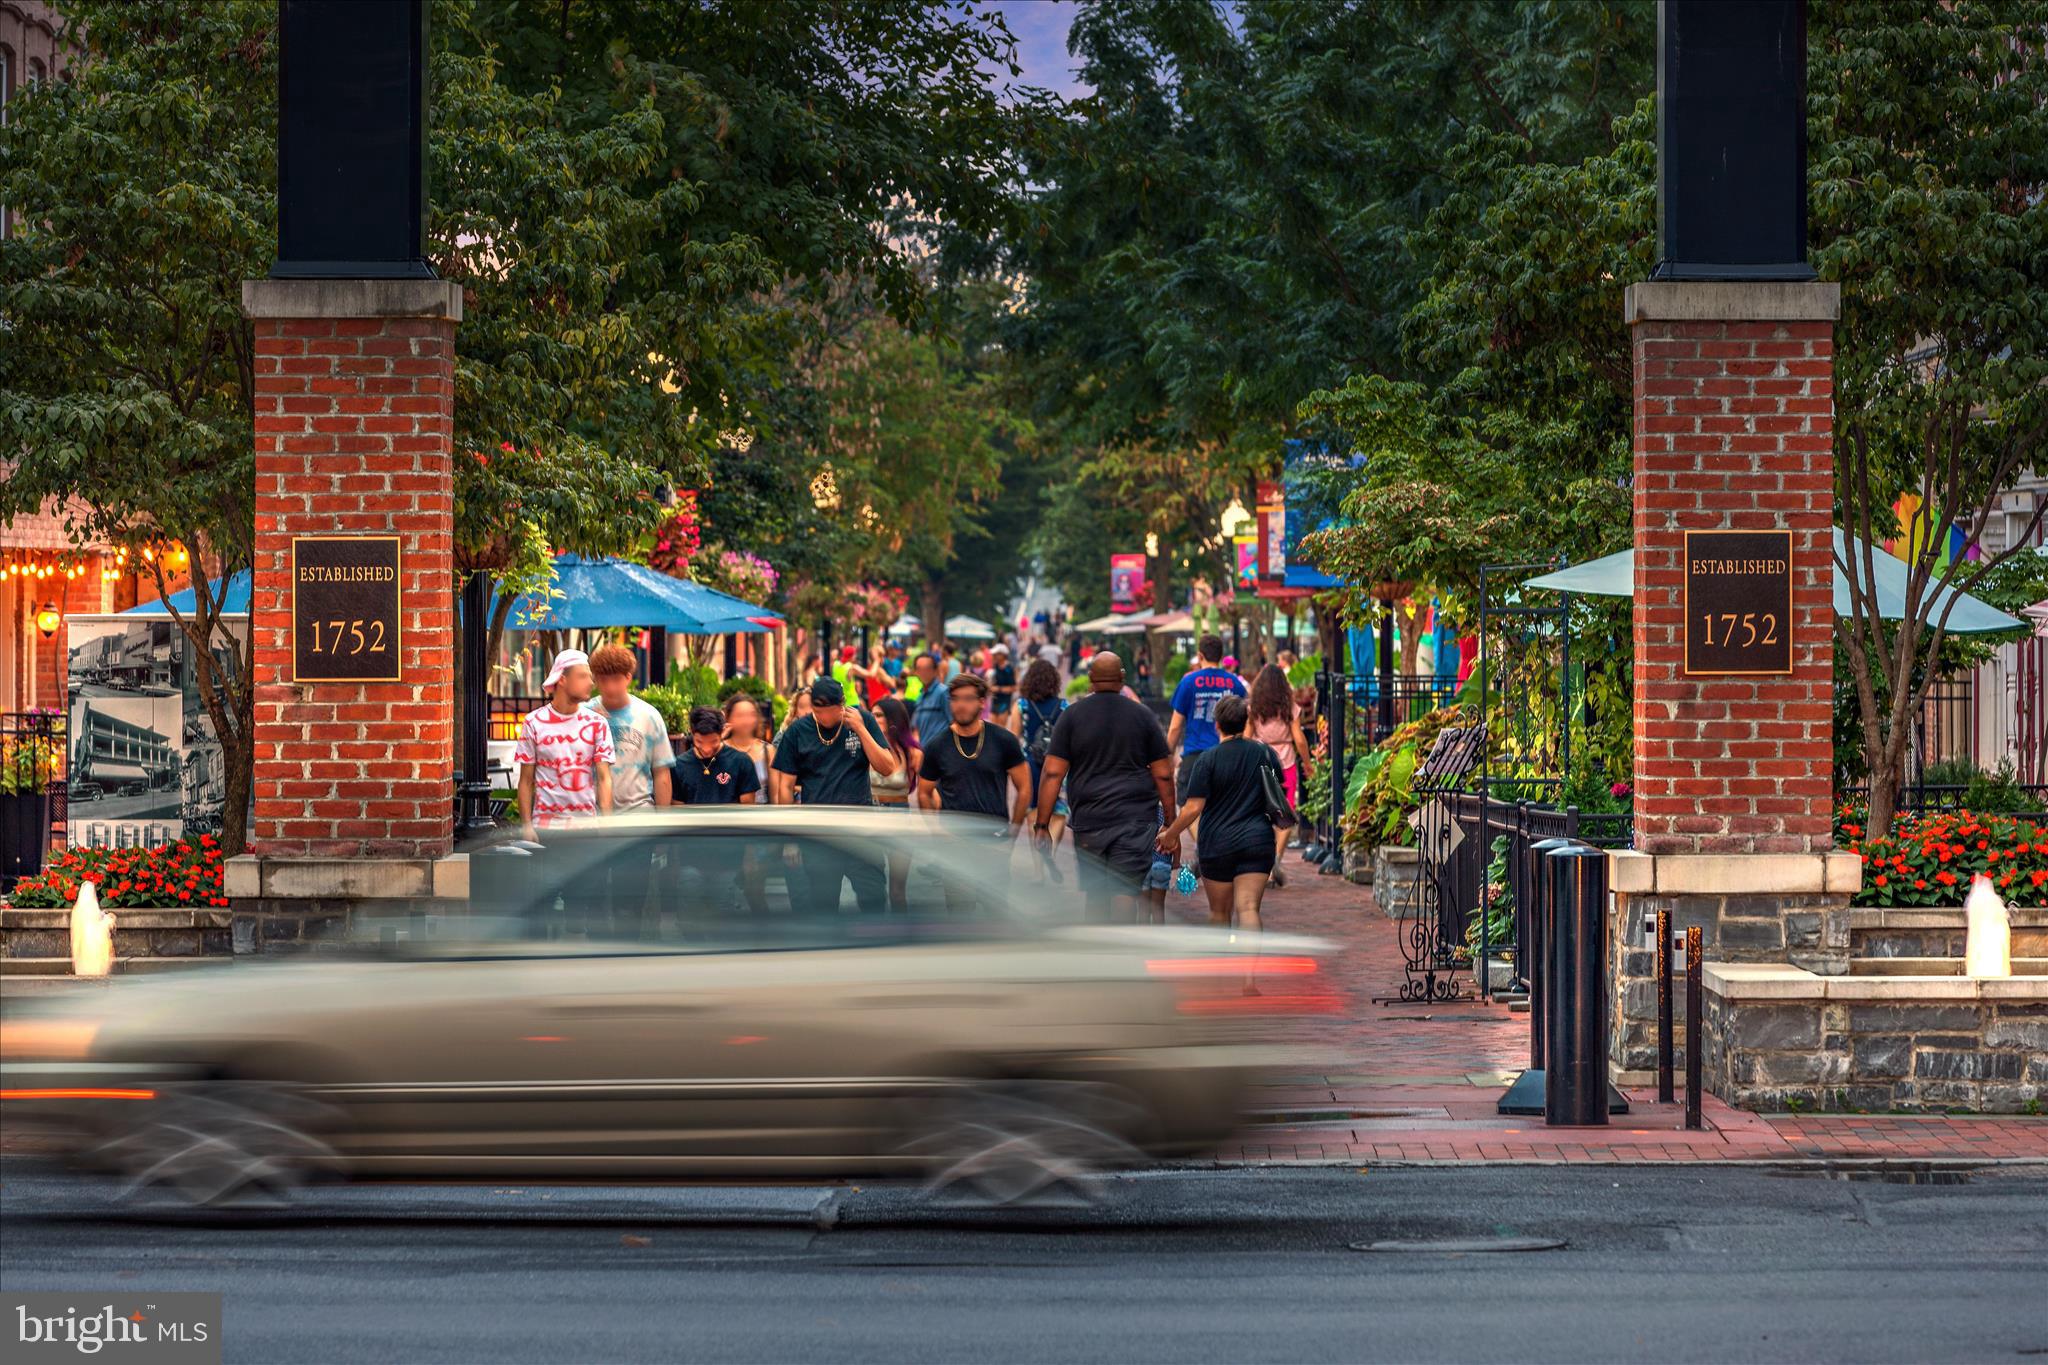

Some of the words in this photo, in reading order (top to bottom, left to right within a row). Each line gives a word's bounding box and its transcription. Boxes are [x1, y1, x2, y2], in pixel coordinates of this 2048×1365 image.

[300, 567, 394, 582] ESTABLISHED
[1692, 560, 1786, 575] ESTABLISHED
[311, 620, 386, 655] 1752
[1704, 613, 1777, 648] 1752
[1195, 675, 1234, 689] CUBS
